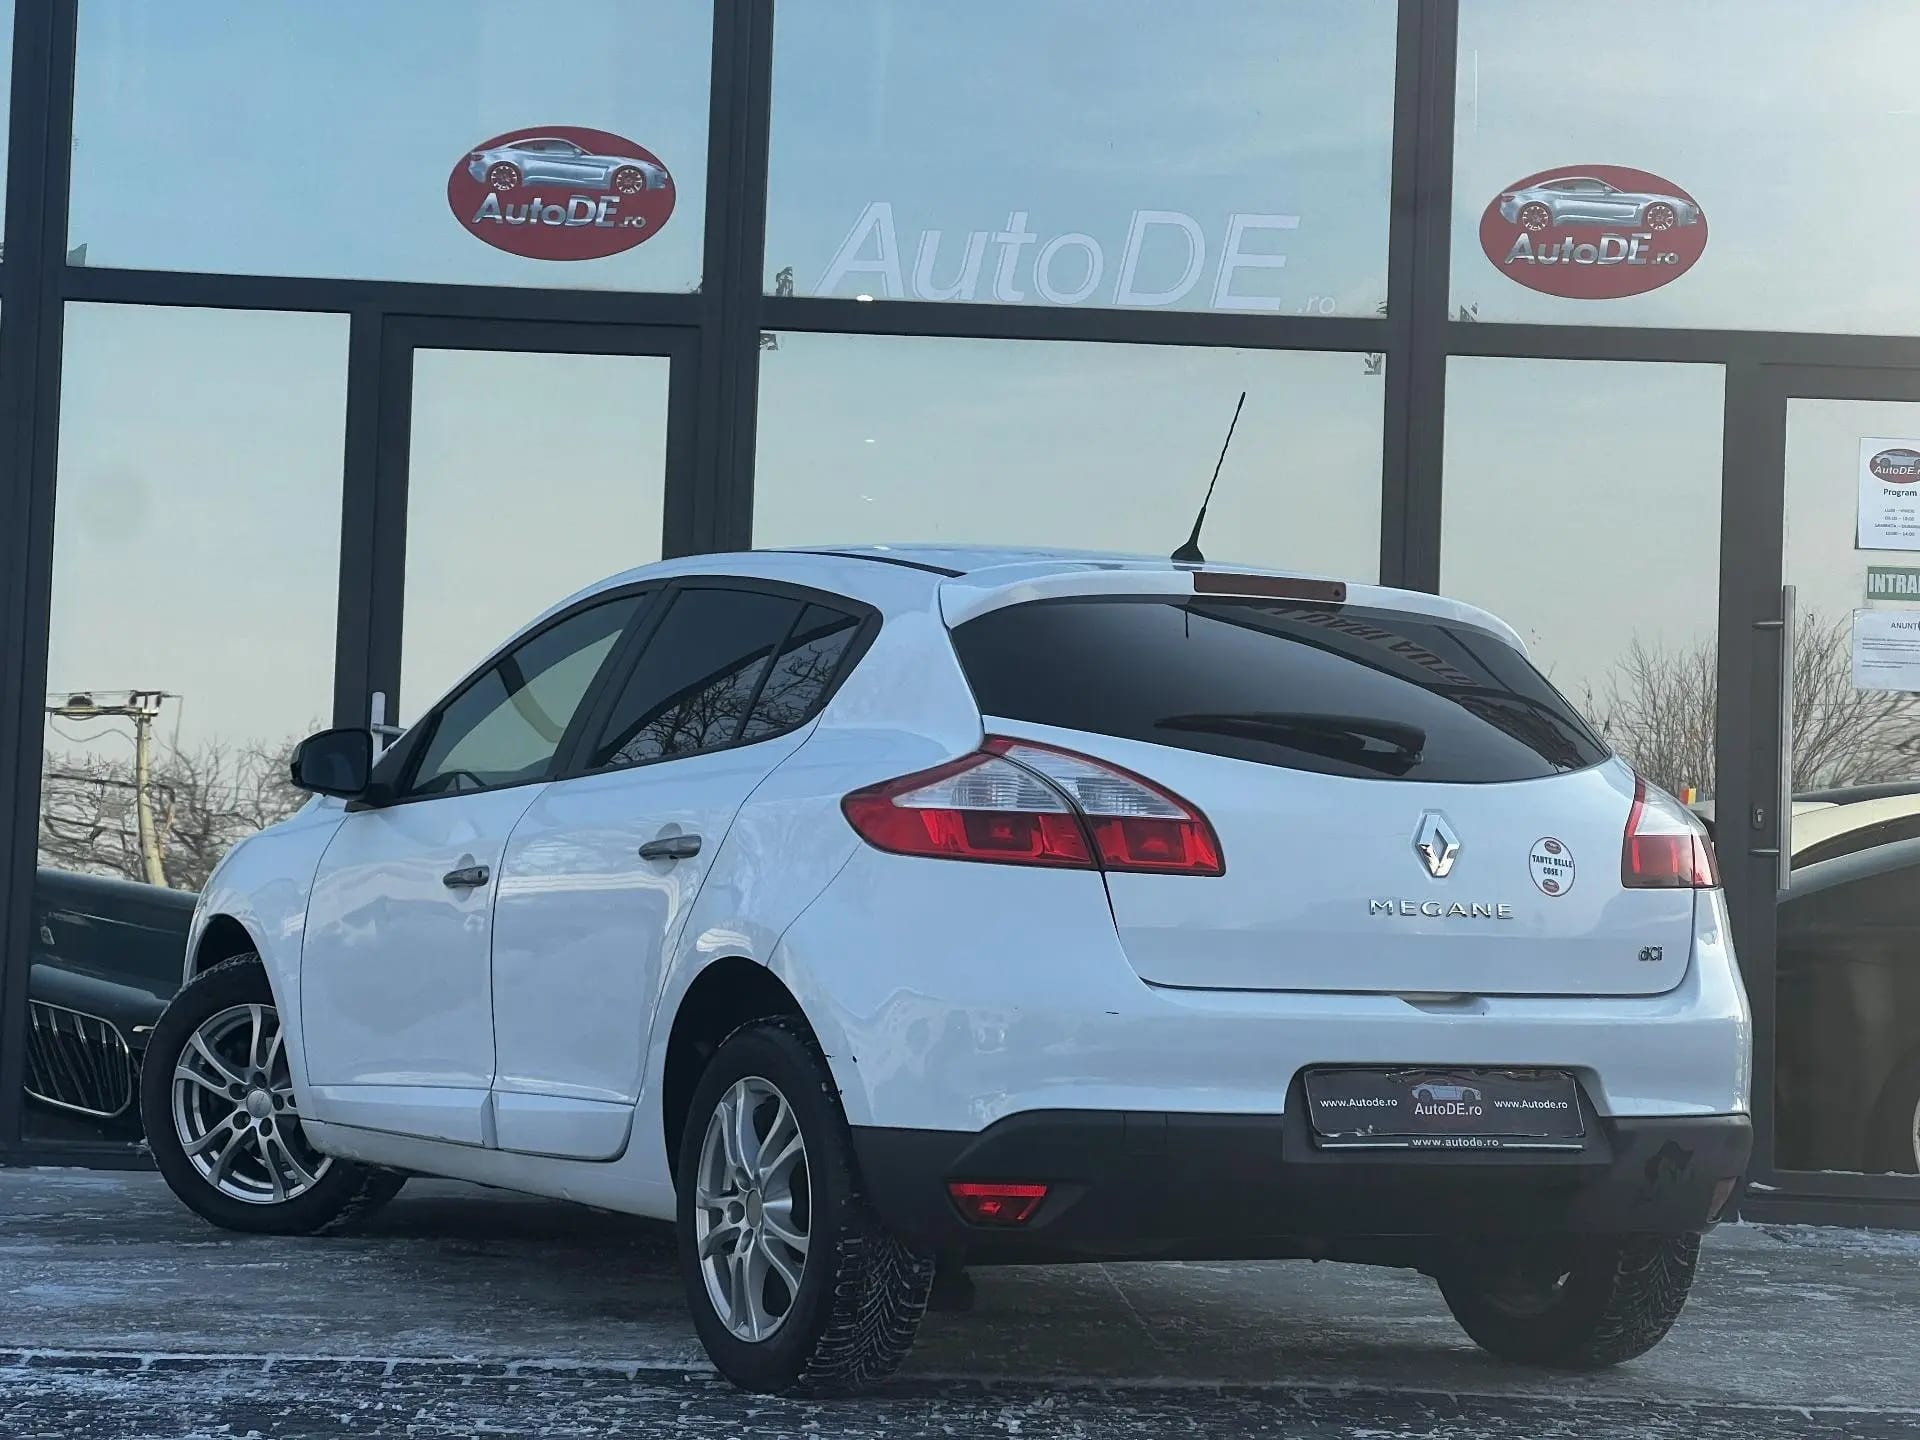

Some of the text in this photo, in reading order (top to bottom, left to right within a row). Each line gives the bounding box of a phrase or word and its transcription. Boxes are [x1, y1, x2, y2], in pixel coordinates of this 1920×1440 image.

[1883, 488, 1918, 497] Program
[1868, 573, 1920, 594] INTRA
[1369, 898, 1514, 920] MEGANE
[1319, 1096, 1398, 1108] www.Autode.ro
[1494, 1098, 1568, 1110] www.Autode.ro
[1414, 1102, 1483, 1117] AutoDE.ro
[1412, 1137, 1499, 1148] www.autode.ro
